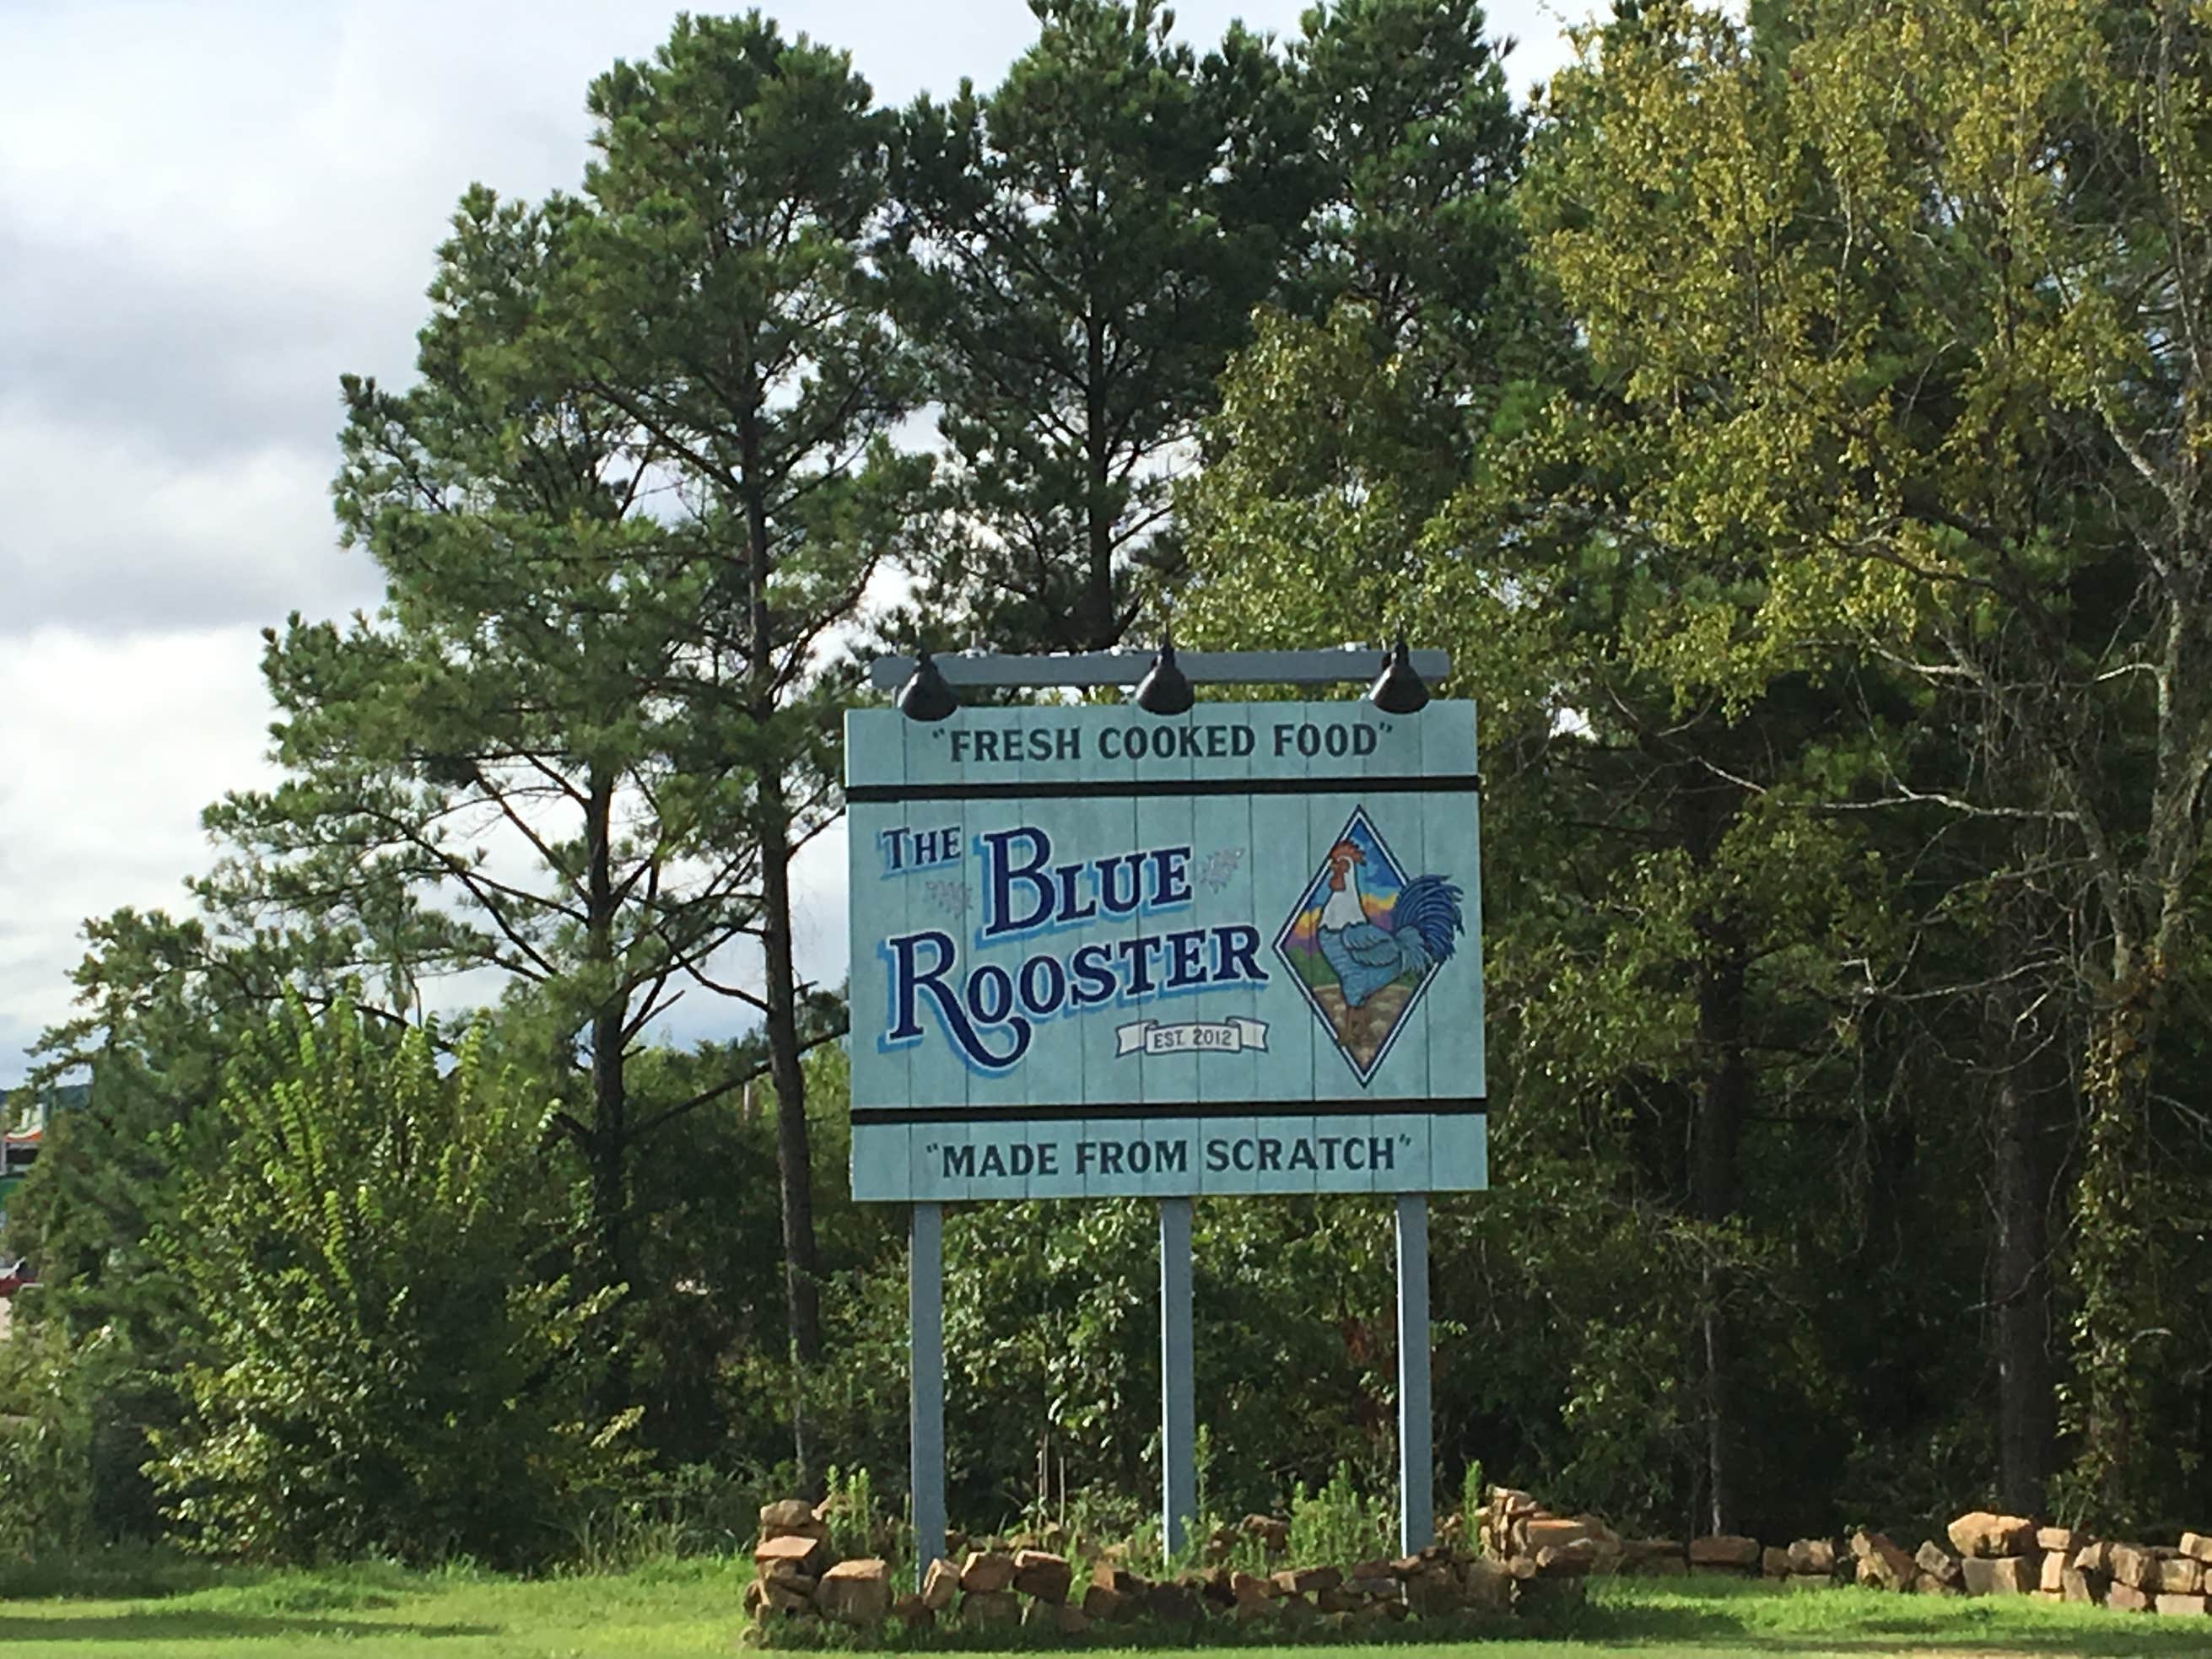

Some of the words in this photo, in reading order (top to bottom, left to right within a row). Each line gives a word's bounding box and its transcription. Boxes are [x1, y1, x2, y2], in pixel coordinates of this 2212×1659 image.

[1098, 724, 1255, 760] COOKED
[1193, 1028, 1233, 1047] 2012
[1076, 1140, 1189, 1175] FROM
